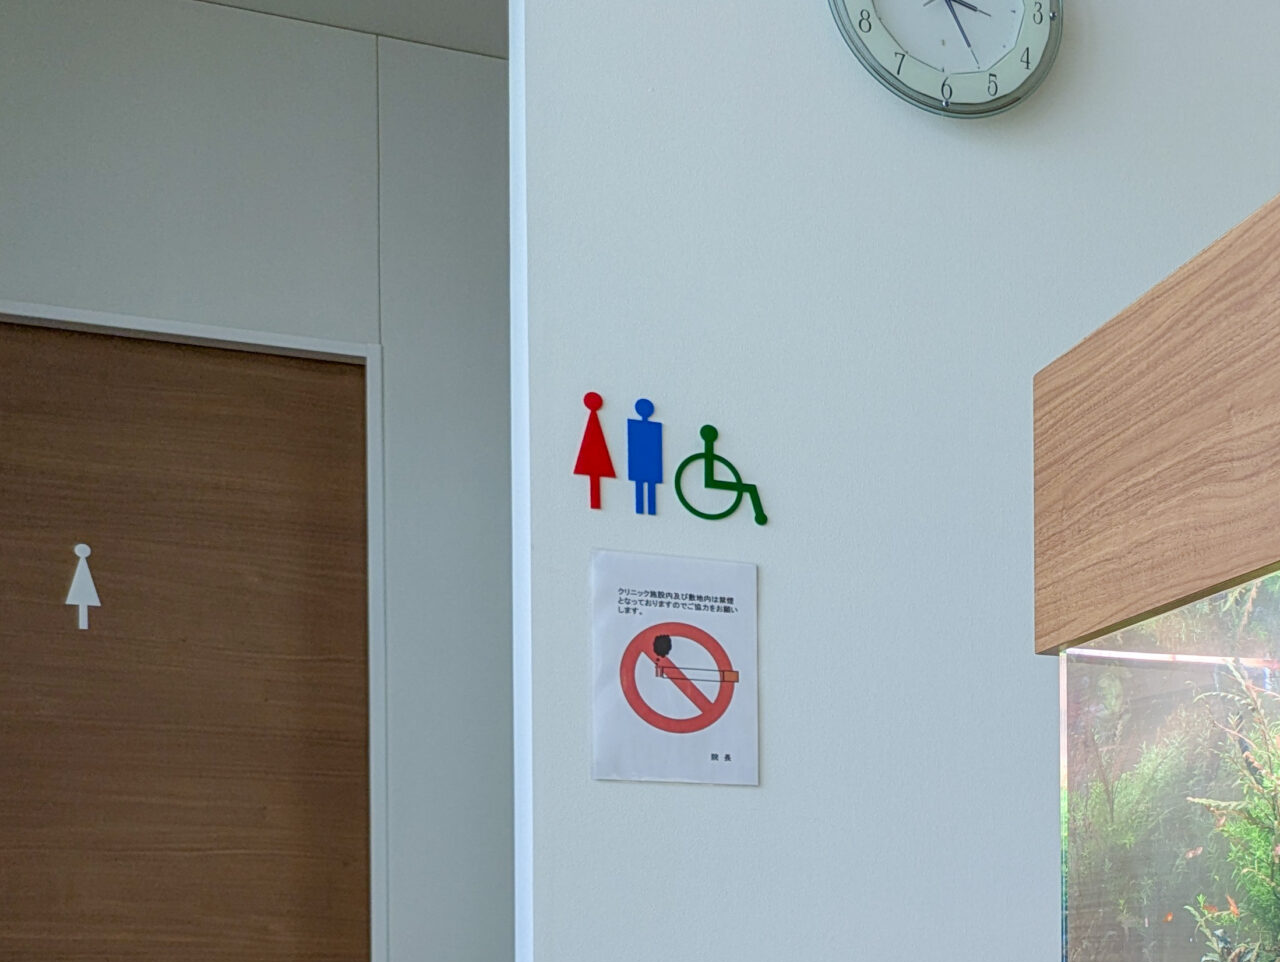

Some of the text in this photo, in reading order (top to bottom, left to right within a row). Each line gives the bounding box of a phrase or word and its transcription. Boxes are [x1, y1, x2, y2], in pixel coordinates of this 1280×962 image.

[858, 9, 872, 33] 8
[1033, 1, 1044, 25] 3
[894, 52, 906, 76] 7
[1020, 47, 1031, 70] 4
[941, 76, 953, 100] 6
[987, 73, 999, 97] 5
[618, 588, 734, 605] クリニック施設内及び敷地内は禁煙
[618, 597, 739, 613] となっておりますのでご協力をお願い
[618, 606, 643, 616] します。
